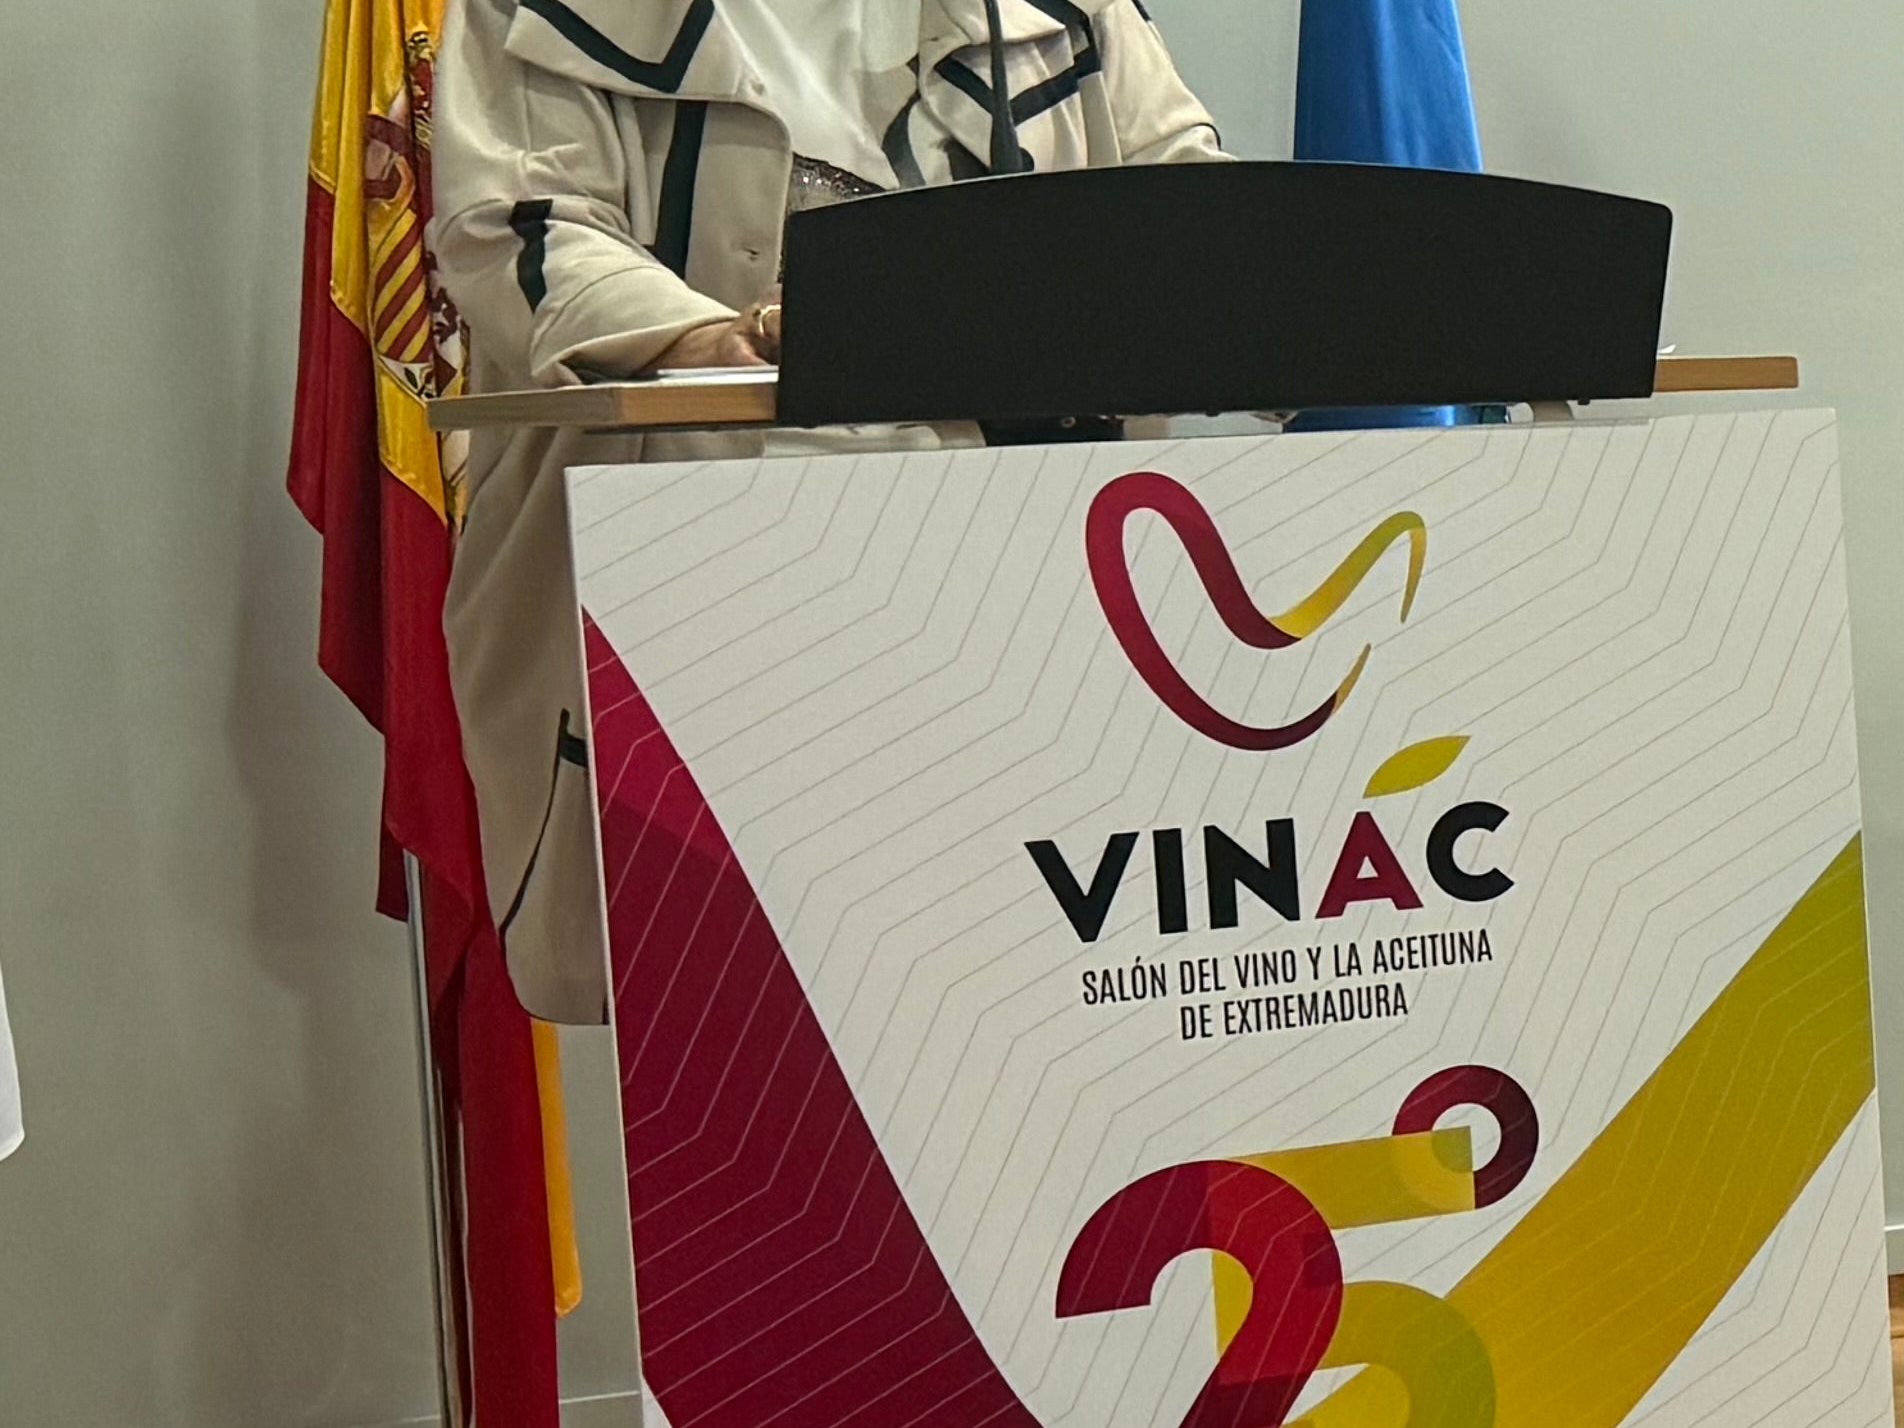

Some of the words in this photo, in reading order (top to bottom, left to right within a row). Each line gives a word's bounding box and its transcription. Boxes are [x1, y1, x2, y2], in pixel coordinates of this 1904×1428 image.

[1082, 956, 1168, 1006] SALÓN
[1179, 956, 1226, 995] DEL
[1234, 948, 1298, 989] VINO
[1306, 946, 1322, 980] Y
[1333, 941, 1363, 979] LA
[1372, 928, 1494, 975] ACEITUNA
[1180, 1004, 1214, 1040] DE
[1223, 982, 1409, 1037] EXTREMADURA
